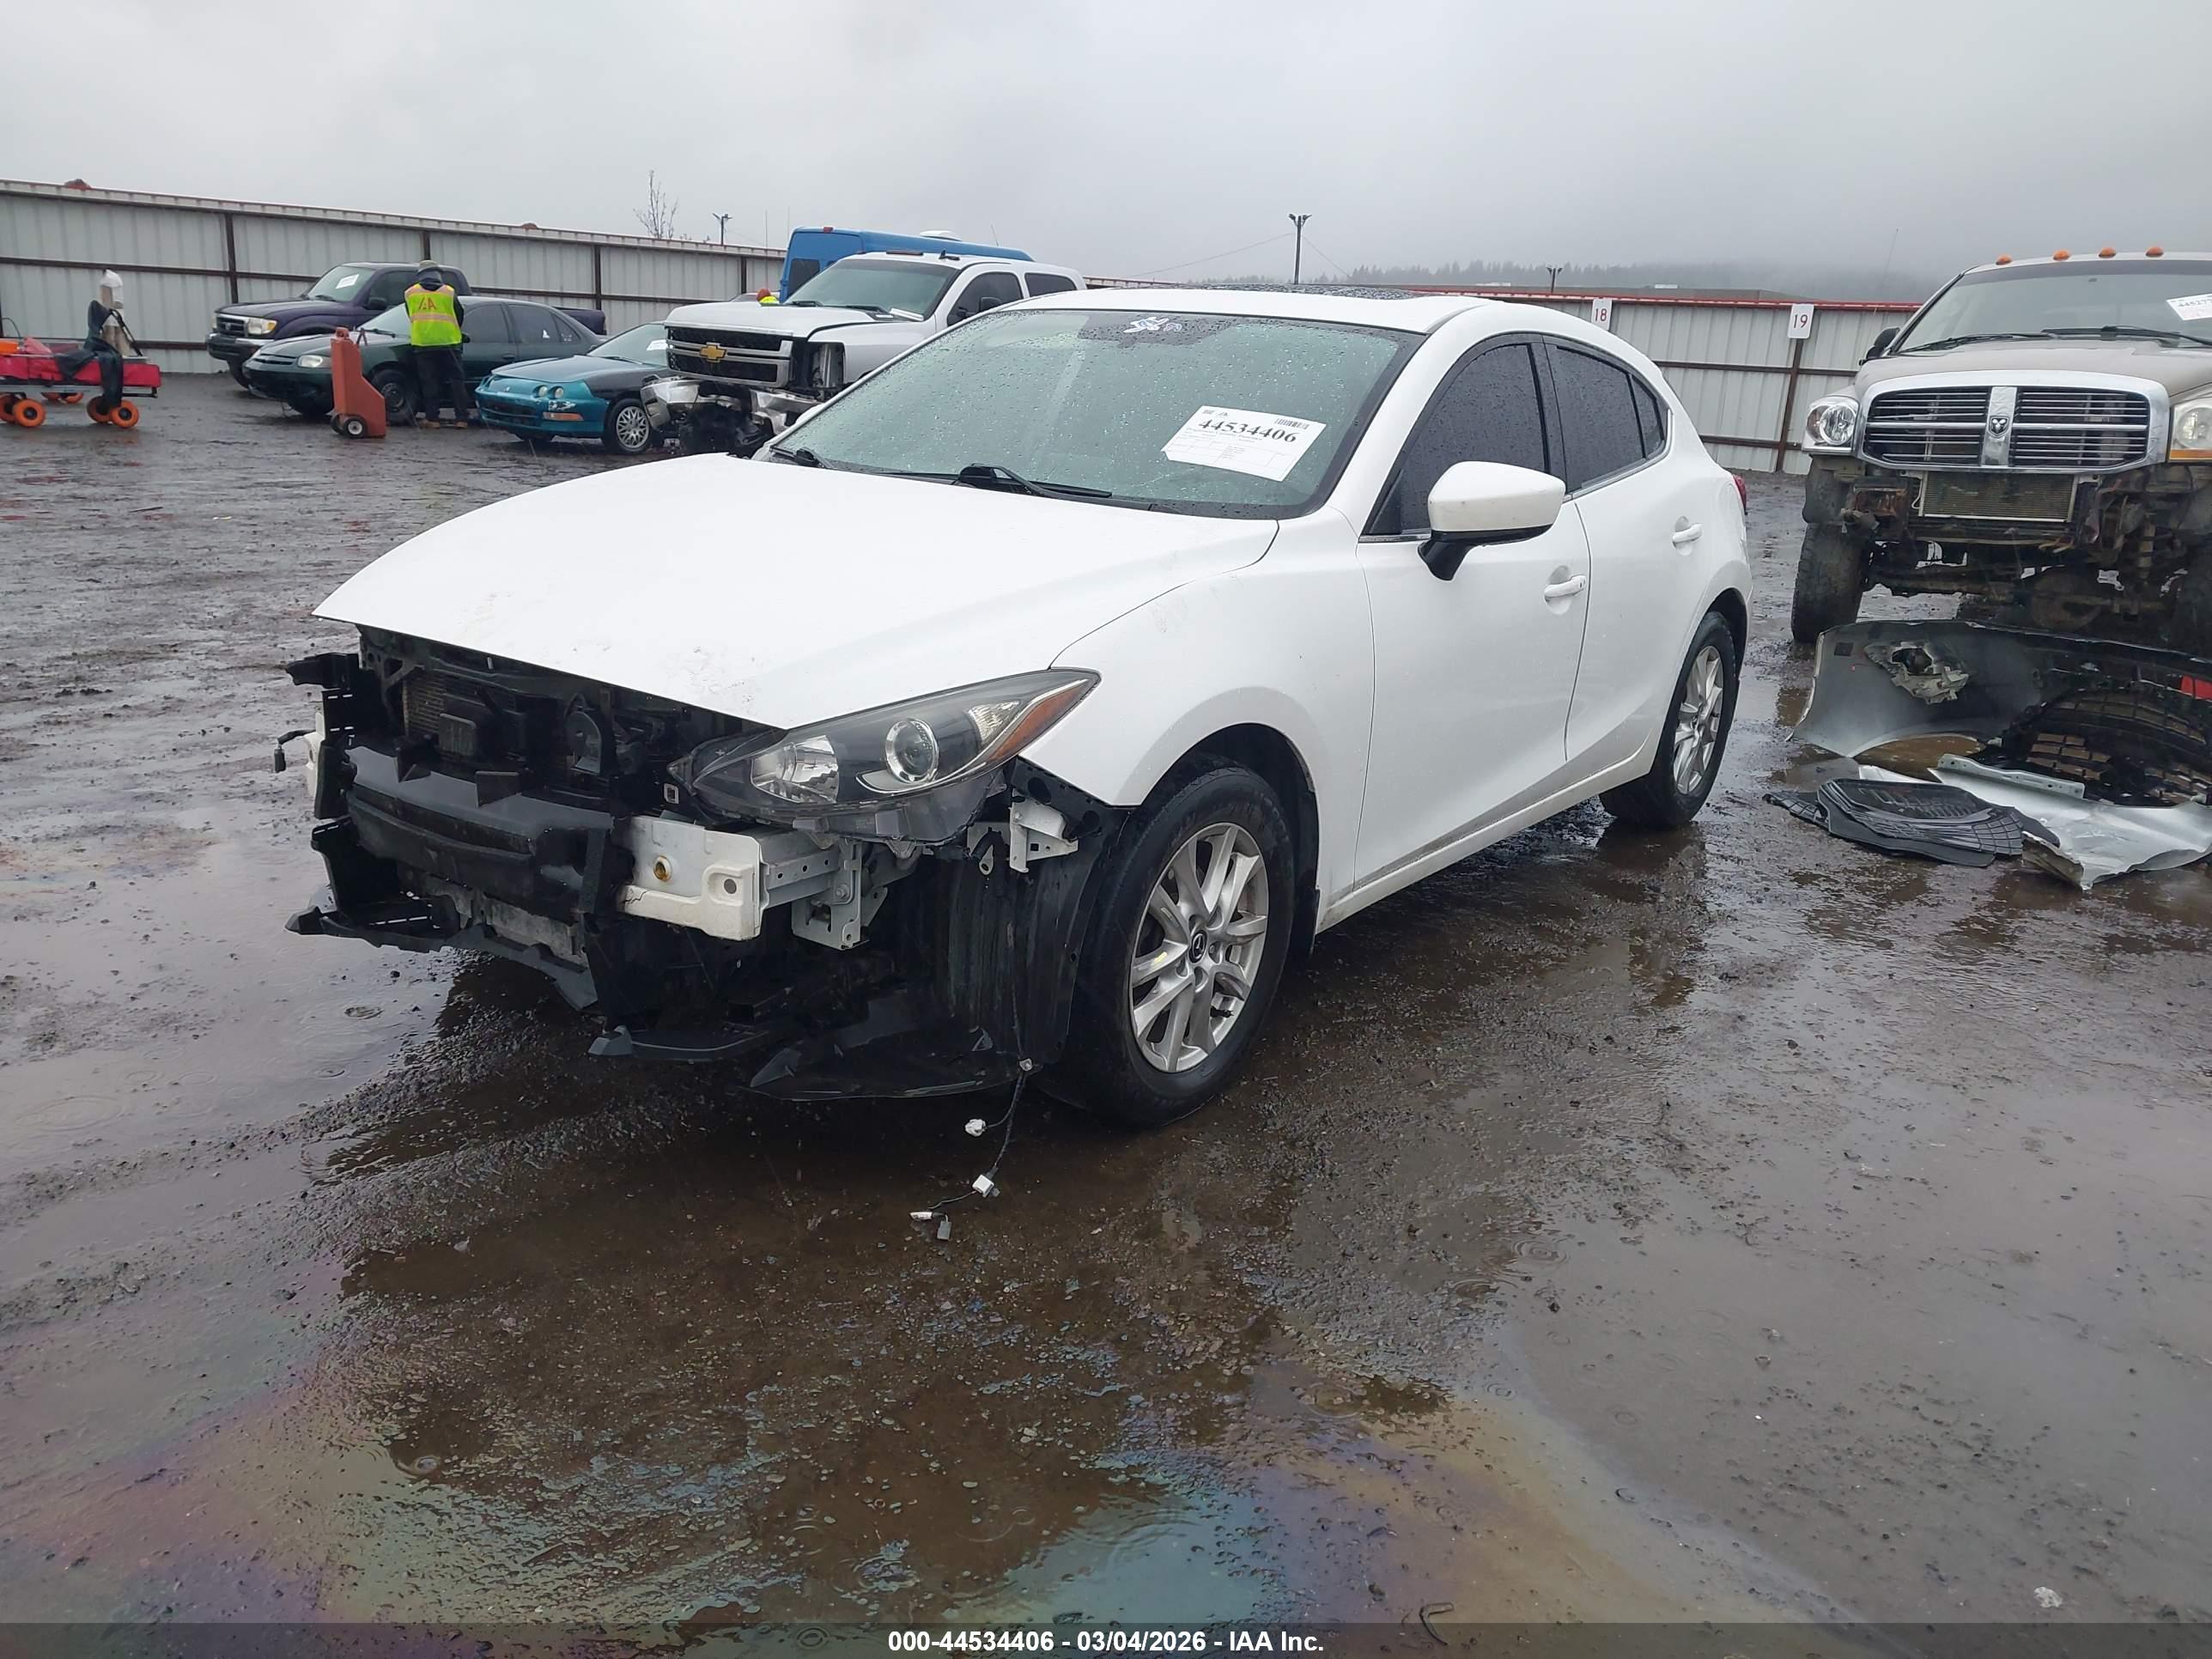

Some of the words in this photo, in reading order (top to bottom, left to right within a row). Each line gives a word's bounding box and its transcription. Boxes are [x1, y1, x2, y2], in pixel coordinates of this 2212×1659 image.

[1595, 308, 1607, 322] 18
[1793, 314, 1808, 329] 19
[1199, 419, 1299, 443] 44534406
